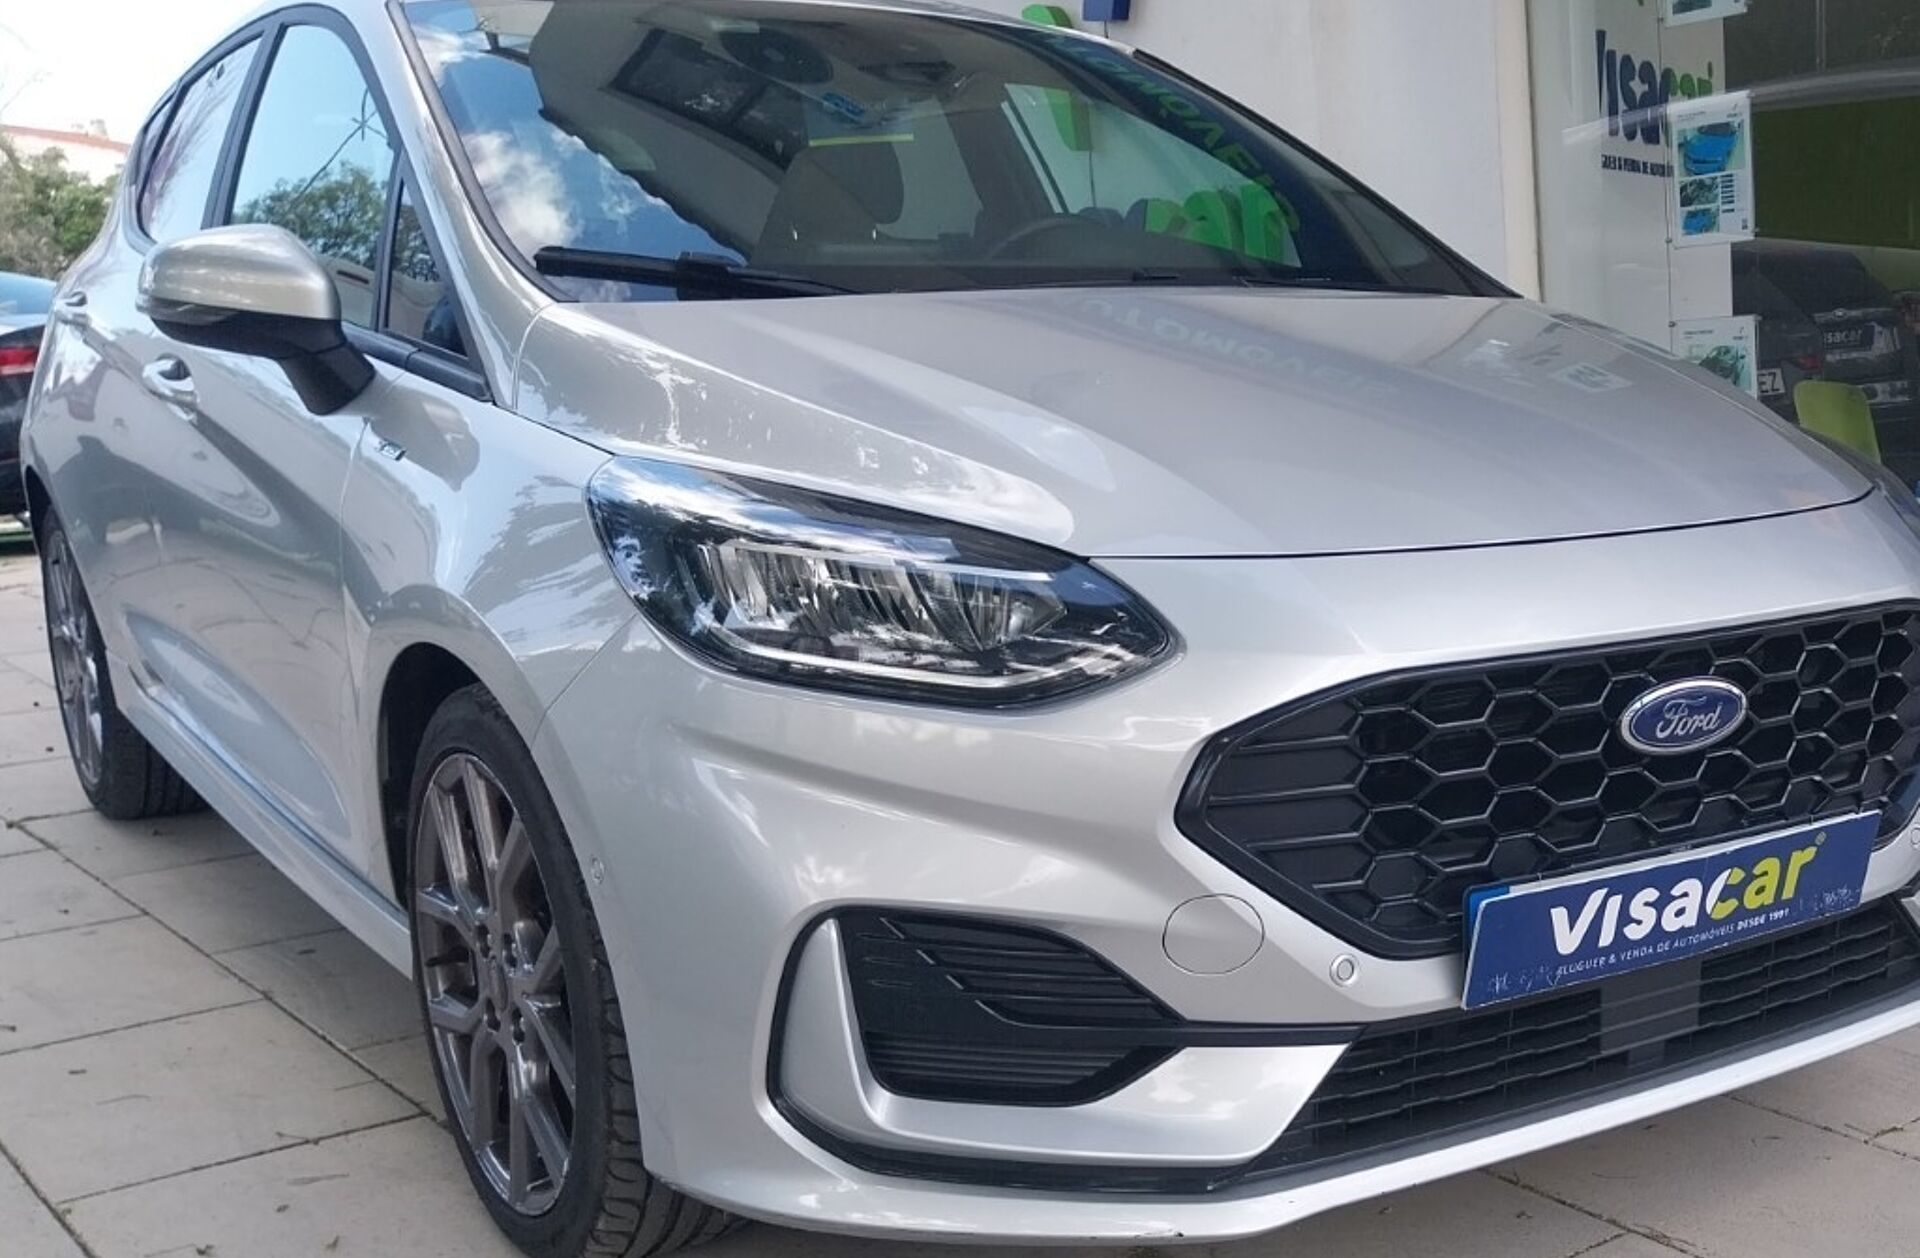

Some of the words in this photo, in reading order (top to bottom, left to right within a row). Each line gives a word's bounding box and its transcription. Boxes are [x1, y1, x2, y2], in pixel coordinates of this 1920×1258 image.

[1655, 696, 1723, 739] Ford
[1608, 952, 1617, 964] &
[1620, 945, 1654, 961] VENDA
[1656, 939, 1670, 953] DE
[1736, 913, 1766, 931] DESDE
